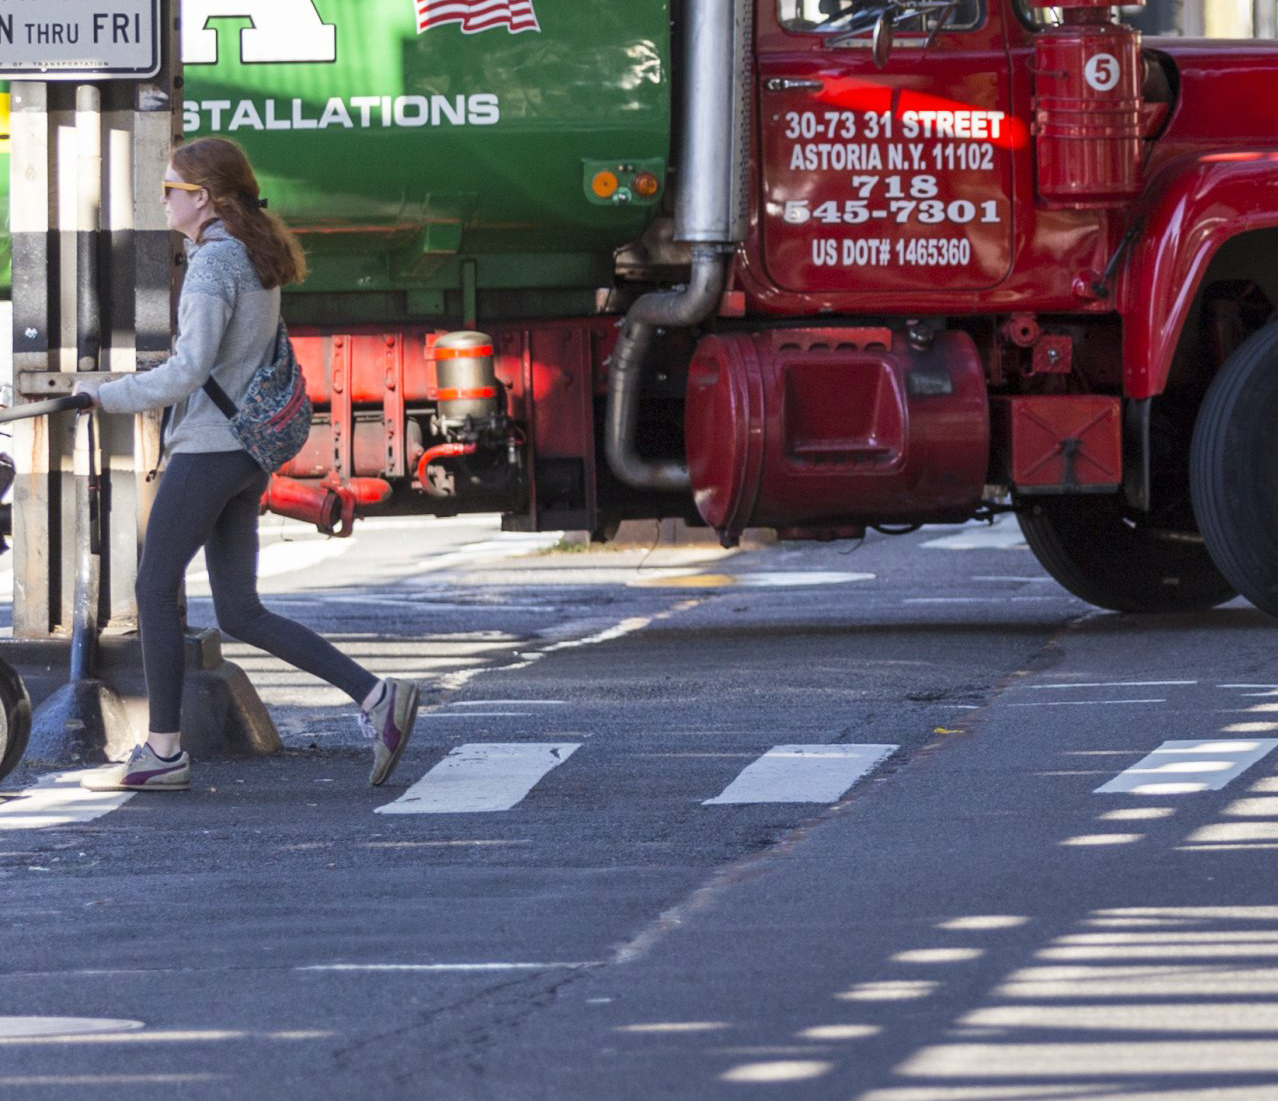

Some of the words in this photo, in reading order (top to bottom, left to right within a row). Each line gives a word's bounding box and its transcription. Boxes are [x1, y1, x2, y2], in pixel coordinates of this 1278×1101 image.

[24, 23, 79, 44] THRU
[93, 13, 140, 44] FRI
[1095, 59, 1111, 84] 5
[785, 111, 856, 139] 30-73
[864, 111, 892, 139] 31
[902, 110, 1005, 139] STREET
[790, 143, 882, 170] ASTORIA
[888, 143, 926, 170] N.Y.
[932, 143, 994, 170] 11102
[852, 175, 938, 198] 718
[783, 200, 1001, 224] 545-7301
[812, 239, 837, 266] US
[843, 238, 890, 266] DOT#
[896, 239, 970, 266] 1465360
